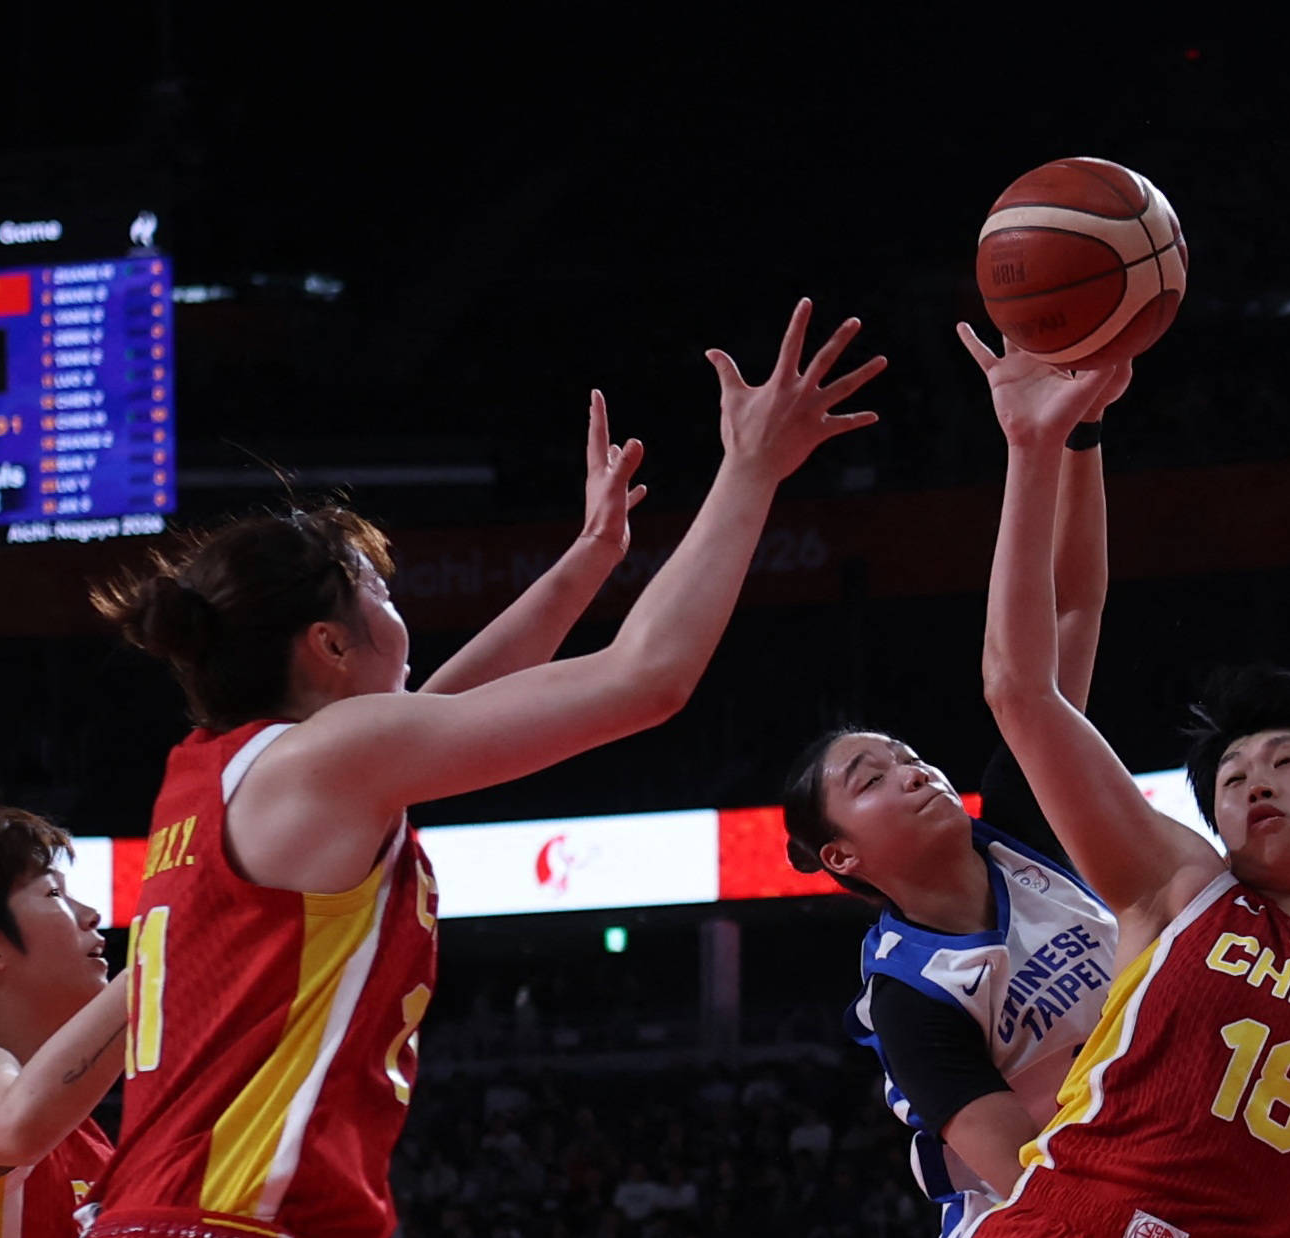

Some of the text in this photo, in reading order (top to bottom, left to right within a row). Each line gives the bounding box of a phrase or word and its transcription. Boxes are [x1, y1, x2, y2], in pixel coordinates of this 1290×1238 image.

[0, 220, 62, 245] Game
[997, 924, 1101, 1044] CHINESE
[1021, 958, 1111, 1042] TAIPEI
